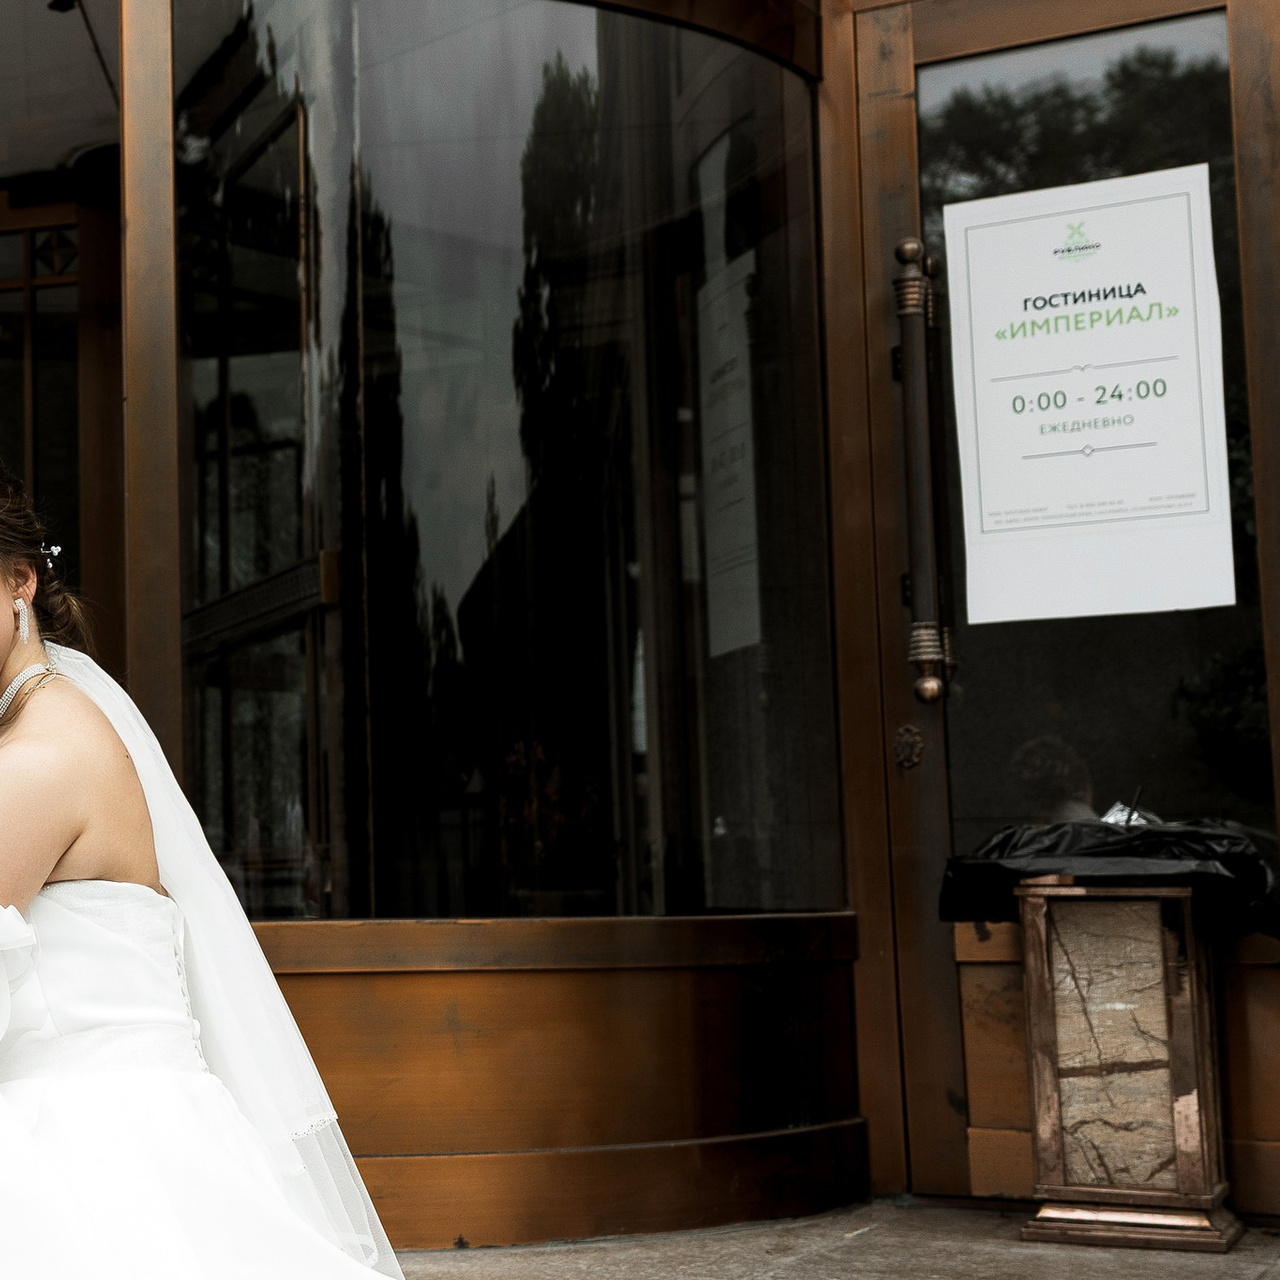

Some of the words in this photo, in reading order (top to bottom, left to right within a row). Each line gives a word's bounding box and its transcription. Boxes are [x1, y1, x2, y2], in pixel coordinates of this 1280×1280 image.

[1023, 282, 1147, 311] ГОСТИНИЦА
[994, 302, 1180, 341] «ИМПЕРИАЛ»
[1012, 390, 1067, 414] 0:00
[1094, 378, 1167, 405] 24:00
[1039, 414, 1135, 436] ЕЖЕДНЕВНО
